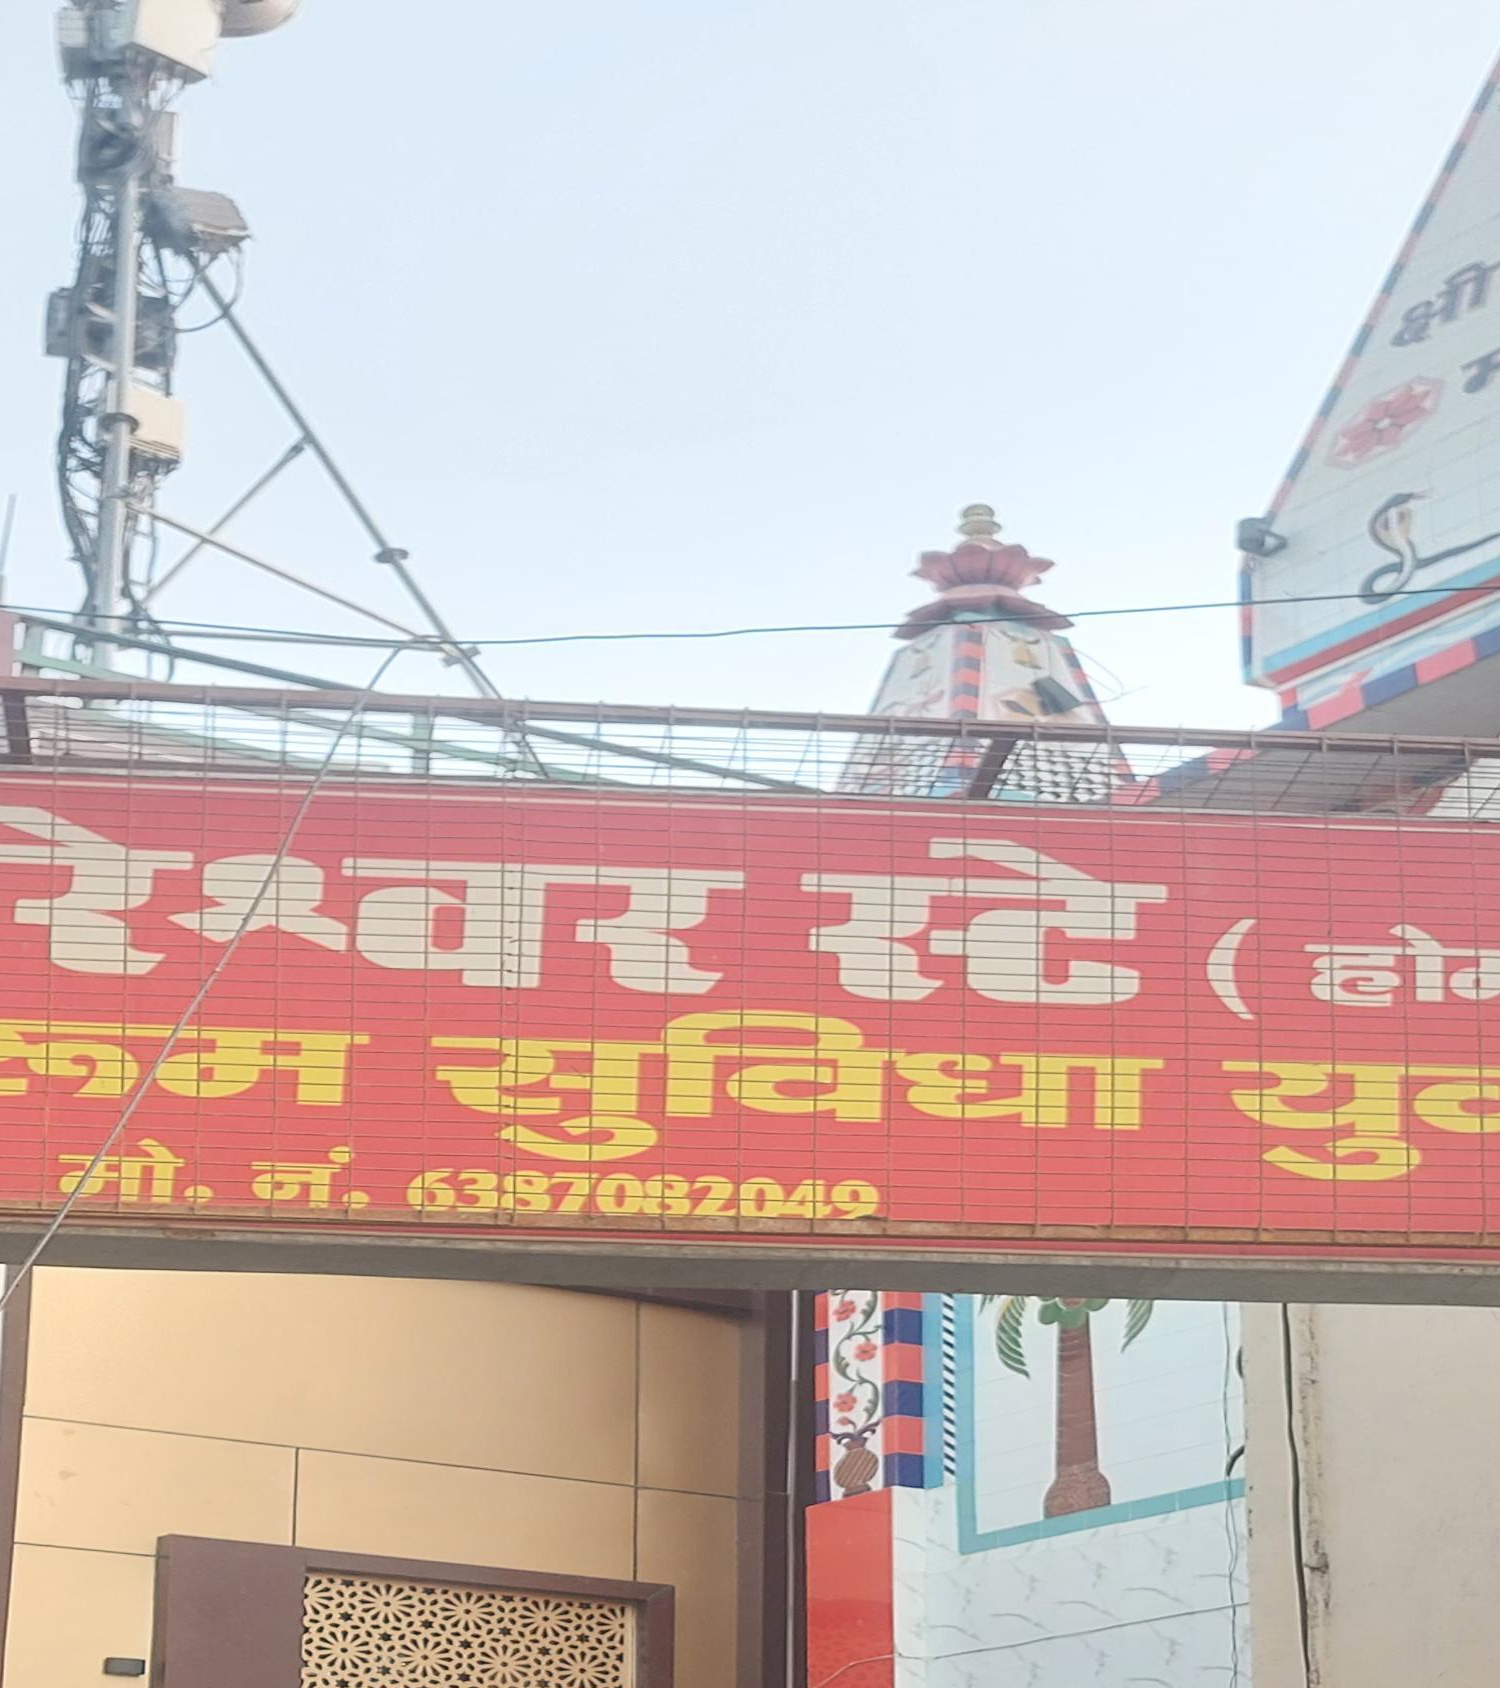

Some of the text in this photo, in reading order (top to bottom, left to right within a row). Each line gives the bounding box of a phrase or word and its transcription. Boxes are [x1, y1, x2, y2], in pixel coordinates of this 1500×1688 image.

[801, 837, 1168, 1005] स्टे
[430, 1011, 1166, 1162] सुविधा
[58, 1137, 880, 1221] मो. नं. 6387082049
